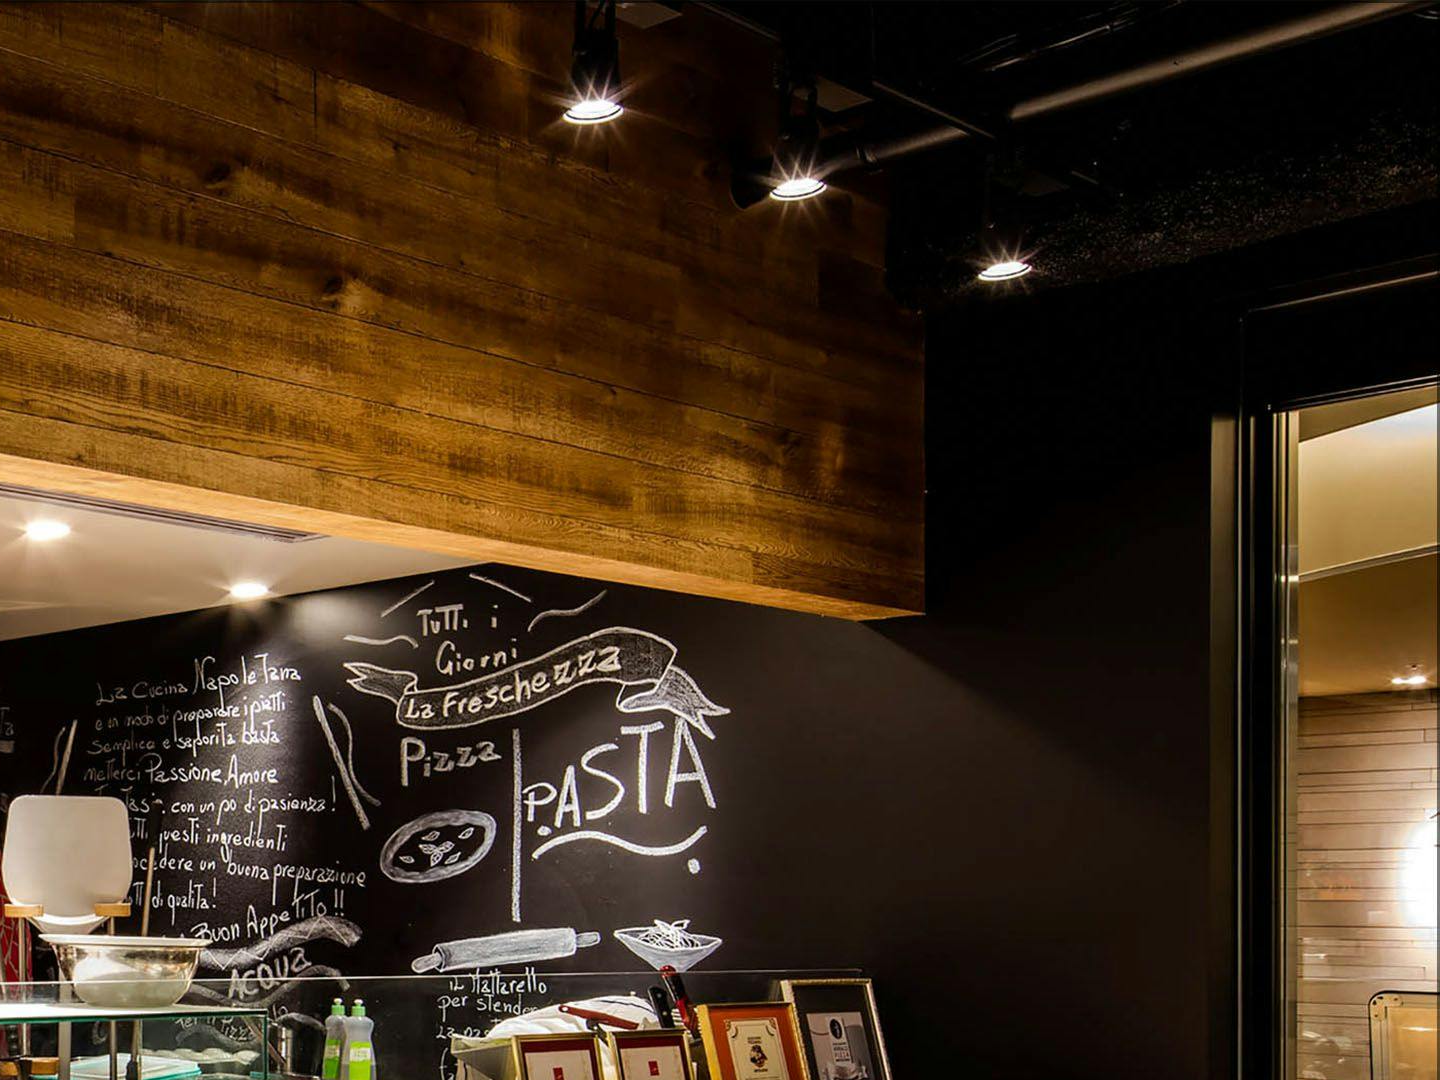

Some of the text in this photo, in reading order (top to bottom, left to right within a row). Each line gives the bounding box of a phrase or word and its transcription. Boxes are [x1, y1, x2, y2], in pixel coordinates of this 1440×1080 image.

[435, 638, 517, 676] Giorni
[404, 645, 622, 720] La Freschezza
[241, 719, 280, 746] basta
[226, 754, 280, 790] Amore
[400, 736, 502, 787] Pizza
[522, 715, 717, 828] PASTA
[171, 801, 195, 813] con
[200, 802, 215, 813] un
[206, 820, 288, 863] ingredienti
[200, 859, 216, 871] un
[226, 849, 270, 881] buona
[191, 921, 240, 942] Buon
[437, 994, 469, 1023] per
